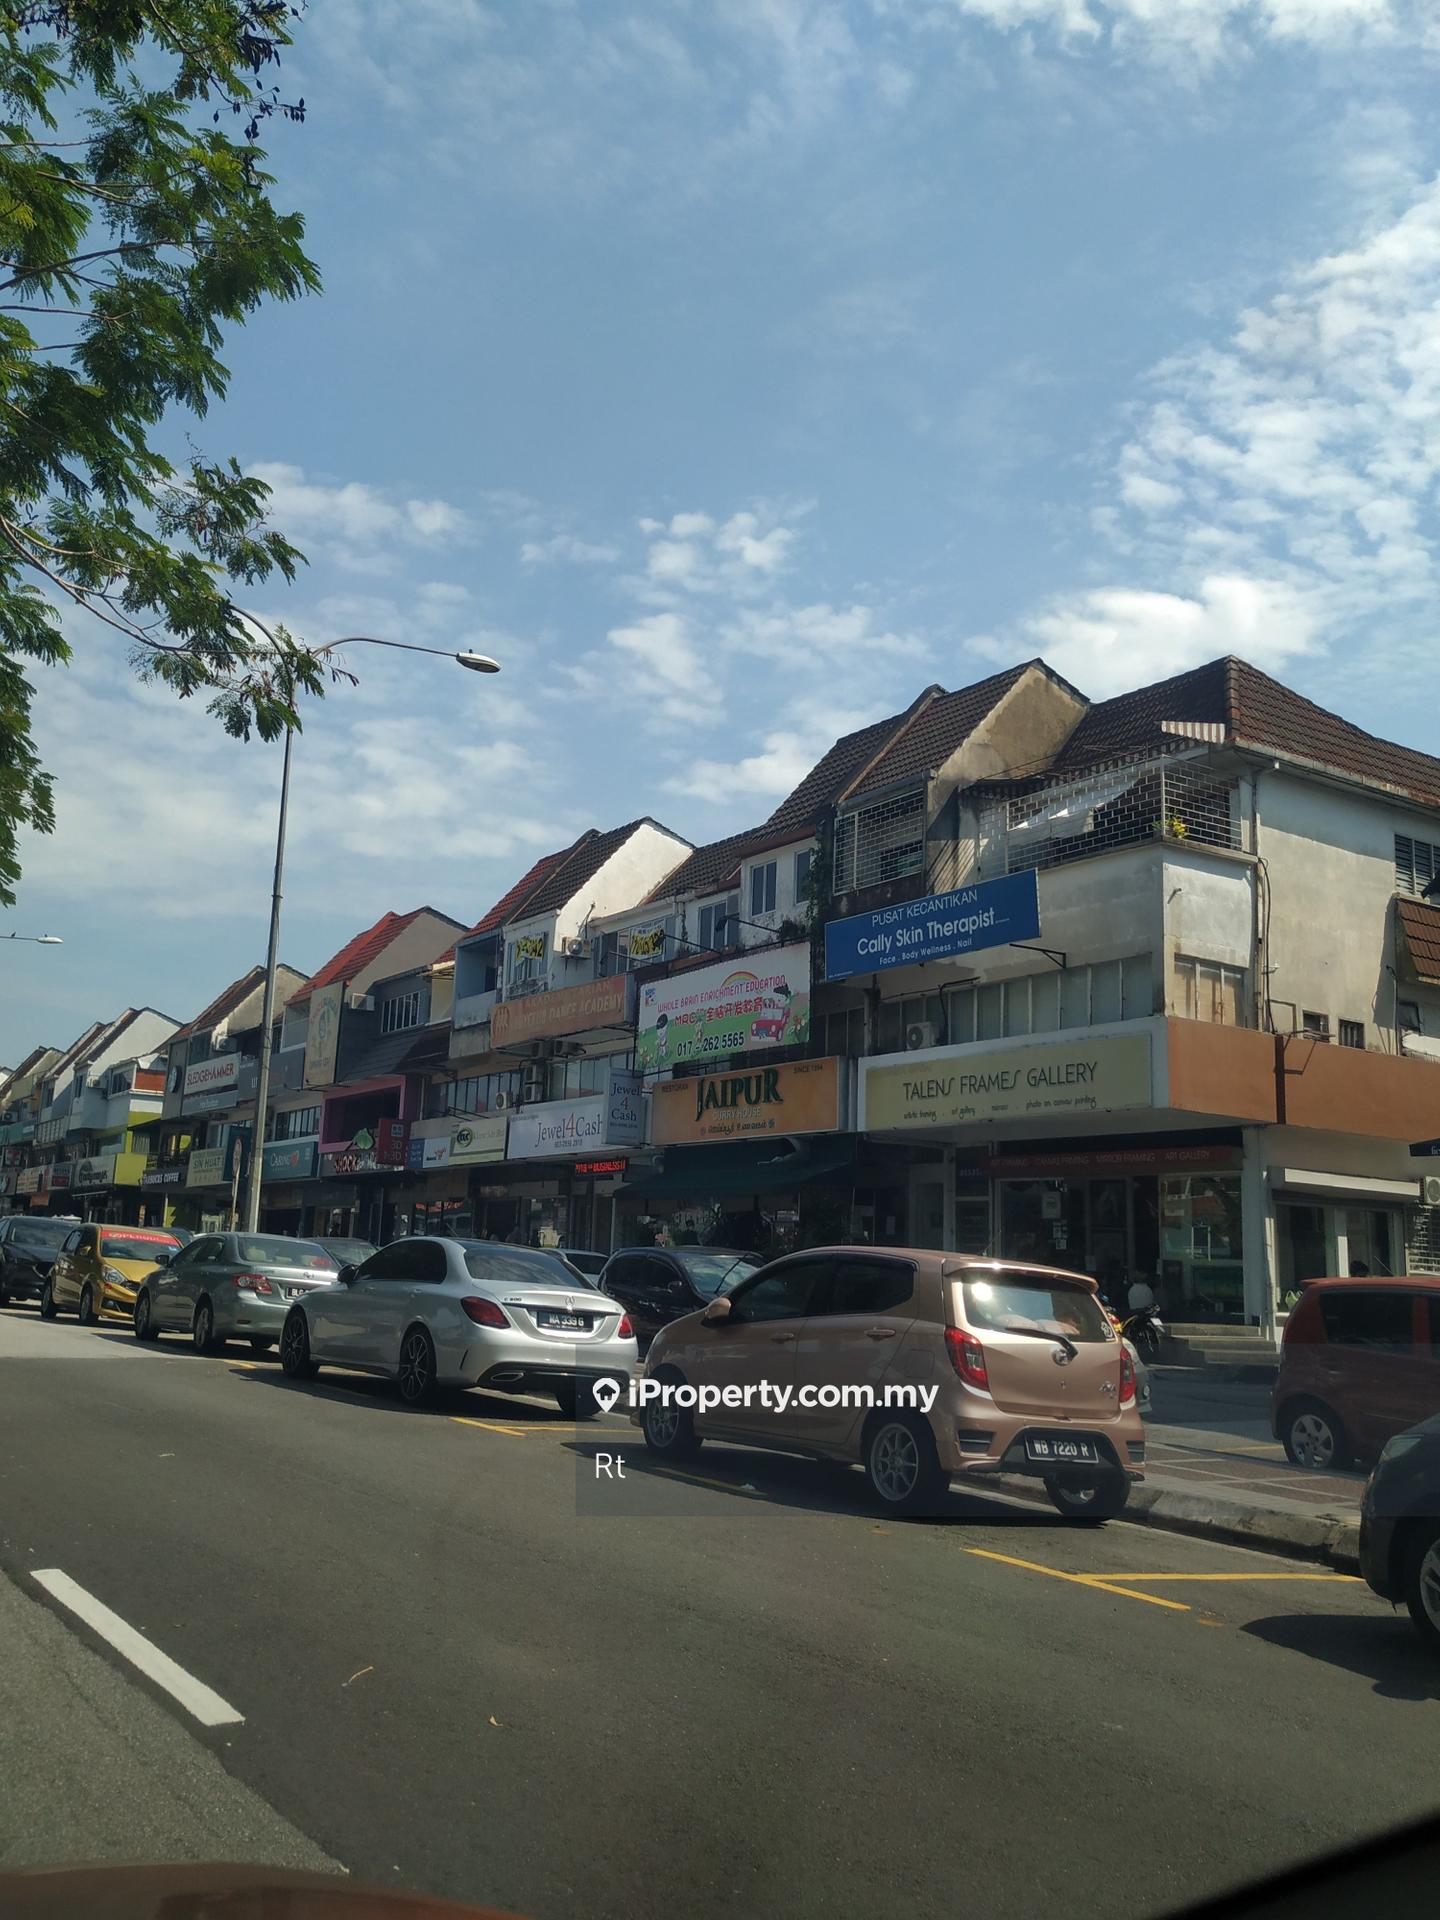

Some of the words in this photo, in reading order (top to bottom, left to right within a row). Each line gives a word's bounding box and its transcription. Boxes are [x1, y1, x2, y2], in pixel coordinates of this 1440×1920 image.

[871, 909, 904, 927] PUSAT
[906, 889, 978, 917] KECANTIKAN
[857, 934, 893, 955] Cally
[896, 927, 924, 947] Skin
[926, 907, 995, 939] Therapist
[879, 955, 896, 966] Face
[902, 950, 919, 961] Body
[921, 944, 951, 956] Wellness
[957, 938, 973, 948] Nail
[658, 1000, 679, 1013] WHOLE
[681, 996, 700, 1009] BRAIN
[700, 983, 744, 1002] ENRICHMENT
[745, 975, 786, 993] EDUCATION
[677, 1041, 693, 1056] 017
[703, 1035, 720, 1051] 262
[721, 1031, 745, 1048] 5565
[187, 1063, 234, 1086] SLEDGEHAMMER
[903, 1077, 955, 1101] TALENS
[960, 1069, 1022, 1094] FRAMES
[1027, 1062, 1098, 1087] GALLERY
[611, 1082, 640, 1097] Jewel
[694, 1068, 784, 1122] JAIPUR
[620, 1097, 628, 1109] 4
[611, 1109, 637, 1122] Cash
[712, 1108, 735, 1121] CURRY
[737, 1106, 761, 1118] HOUSE
[1179, 1149, 1210, 1161] GALLERY
[193, 1159, 203, 1169] SIN
[163, 1172, 179, 1183] COFFEE
[562, 1316, 577, 1326] 339
[1033, 1440, 1049, 1455] WB
[1051, 1440, 1078, 1456] 7220
[1081, 1441, 1089, 1457] R
